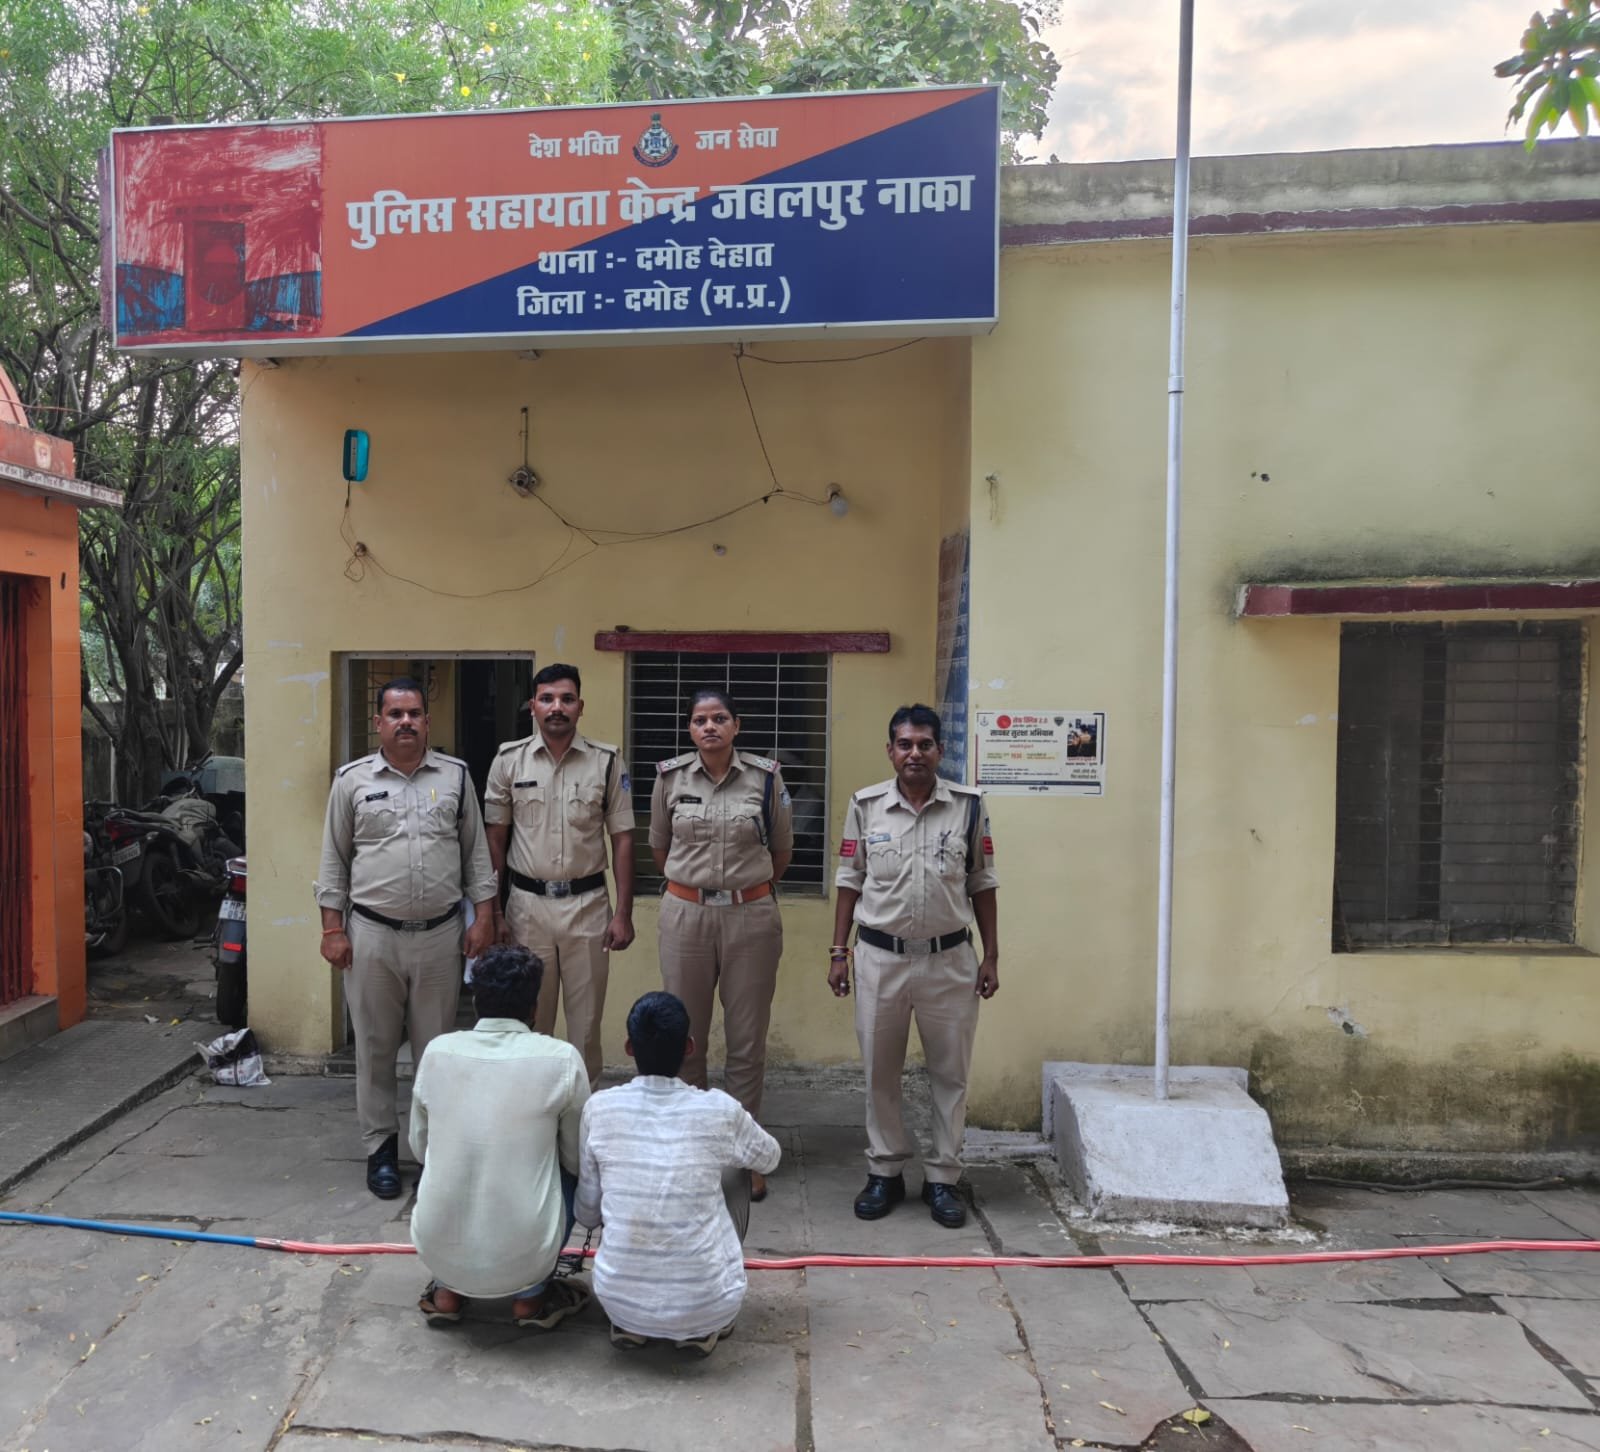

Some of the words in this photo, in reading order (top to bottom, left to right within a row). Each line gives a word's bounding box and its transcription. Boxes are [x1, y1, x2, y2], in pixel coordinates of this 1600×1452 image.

[529, 133, 562, 158] देश
[568, 130, 621, 157] भक्ति
[694, 129, 733, 150] जन
[737, 122, 779, 148] सेवा
[346, 190, 456, 249] पुलिस
[466, 190, 610, 231] सहायता
[618, 177, 699, 225] केन्द्र
[710, 179, 868, 230] जबलपुर
[877, 175, 976, 214] नाका
[538, 250, 597, 275] थाना
[636, 239, 703, 271] दमोह
[708, 237, 775, 268] देहात
[517, 286, 586, 316] जिला
[624, 280, 692, 312] दमोह
[700, 276, 791, 316] (म.प्र.)
